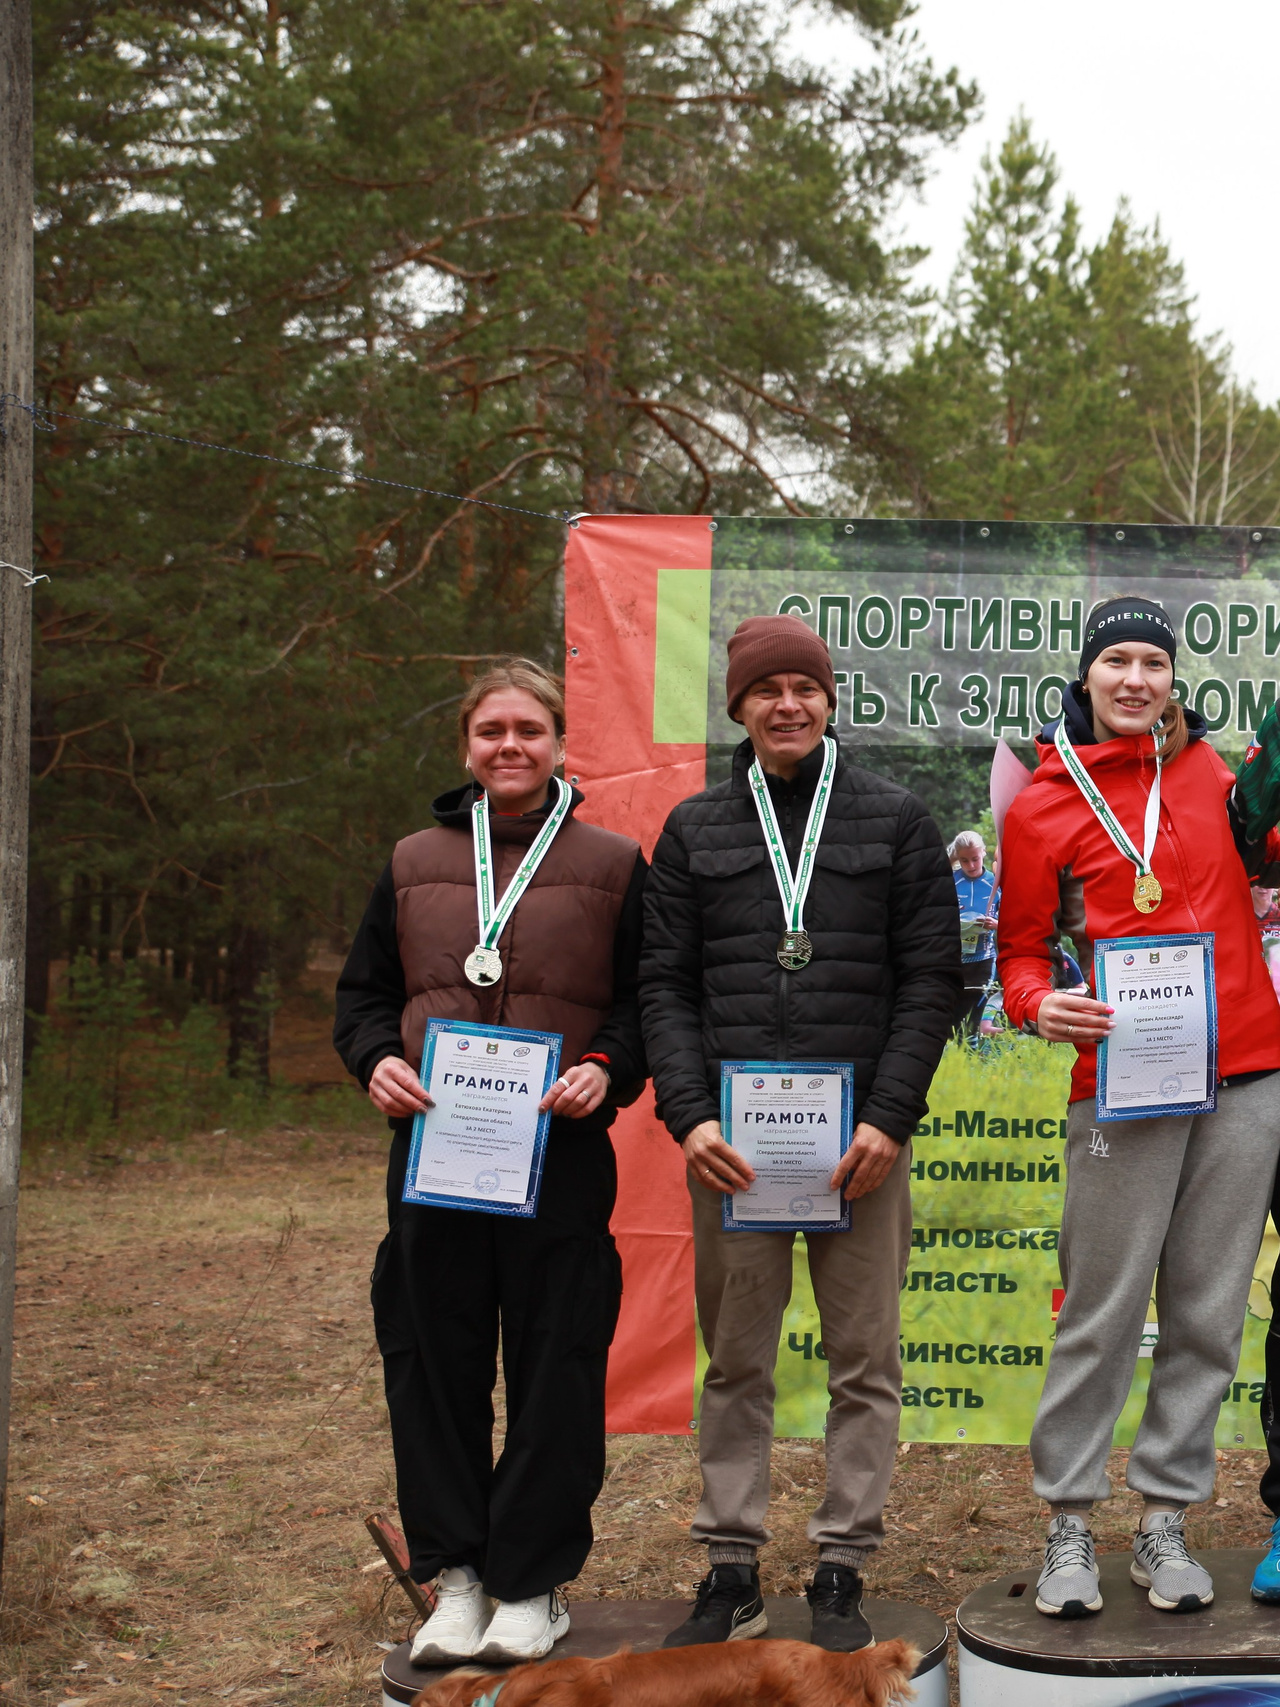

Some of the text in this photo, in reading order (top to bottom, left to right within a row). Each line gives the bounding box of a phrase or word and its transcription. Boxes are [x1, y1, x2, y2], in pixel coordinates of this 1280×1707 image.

[777, 594, 1162, 653] ПОРТИВН
[908, 672, 942, 727] К
[1118, 984, 1193, 1002] ГРАМОТА
[443, 1073, 529, 1093] ГРАМОТА
[744, 1111, 827, 1124] ГРАМОТА
[901, 1271, 1018, 1294] ласть
[901, 1385, 984, 1409] асть
